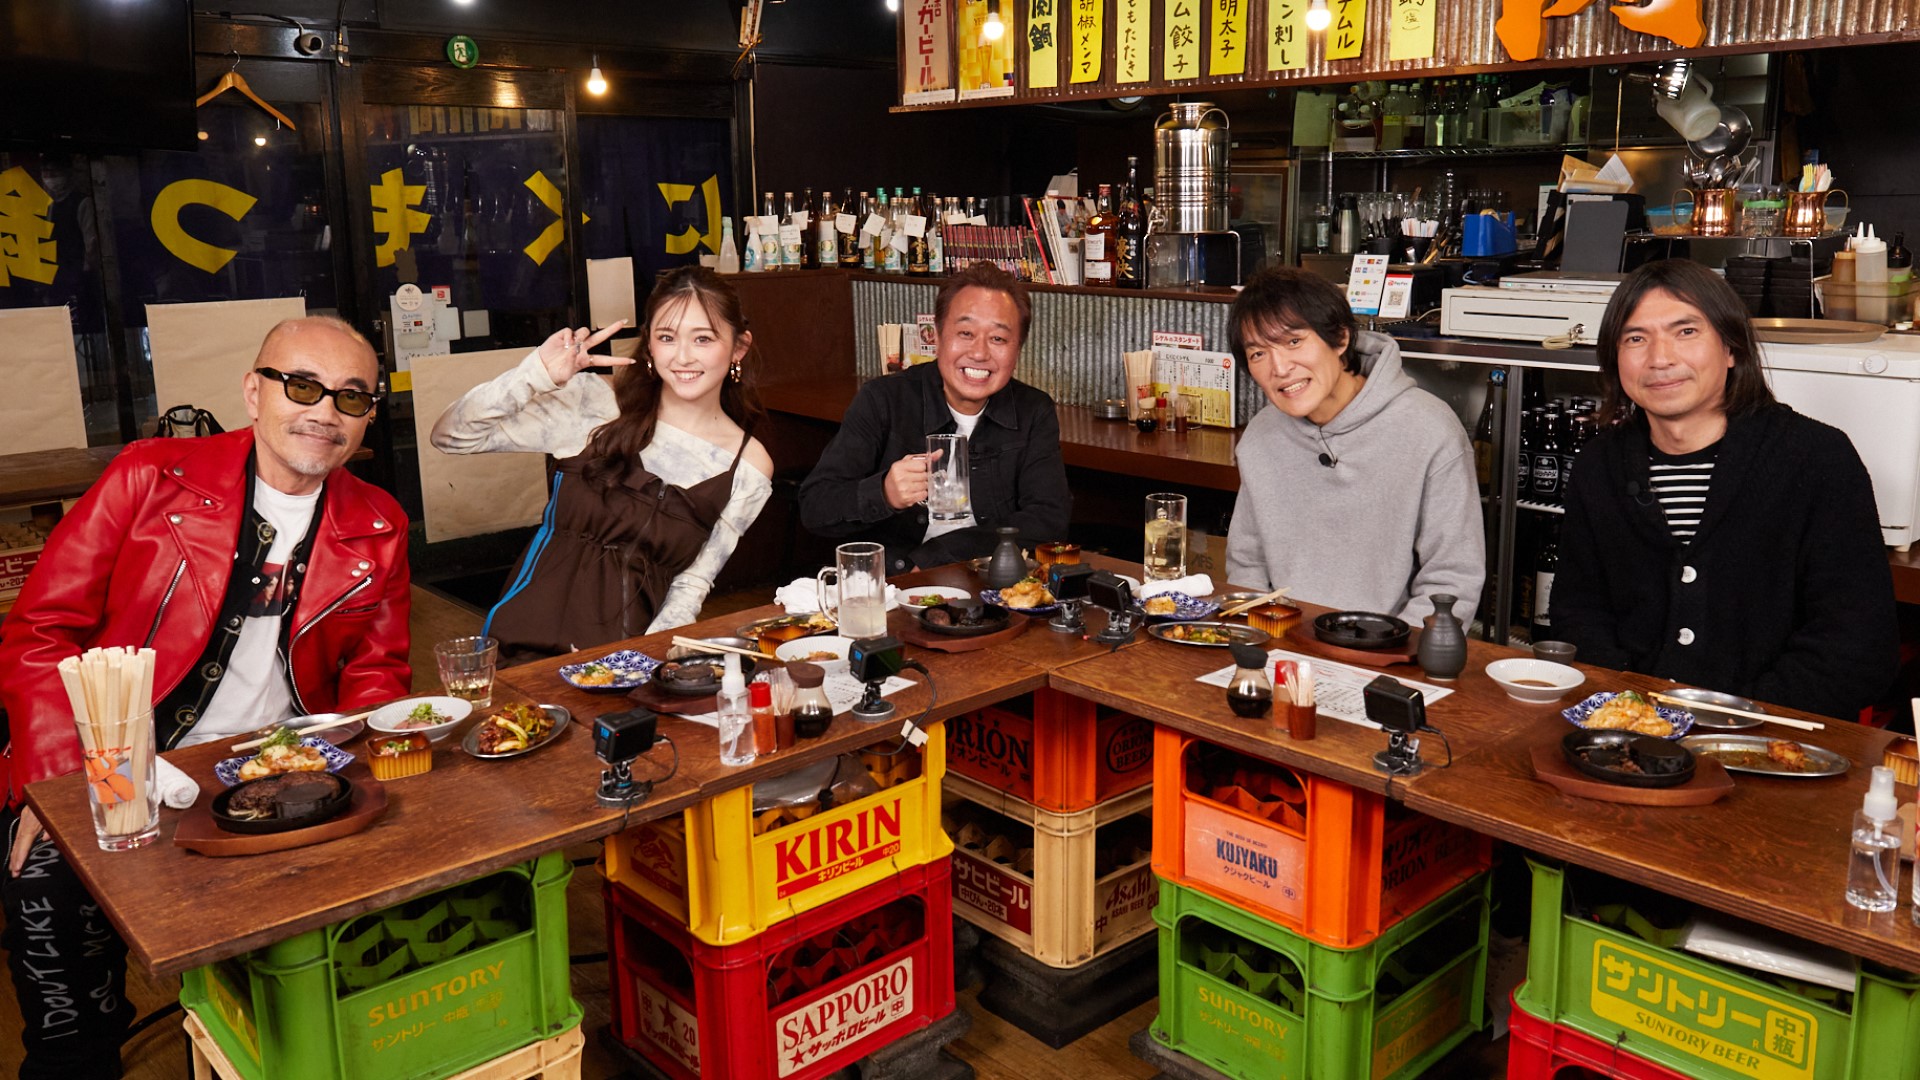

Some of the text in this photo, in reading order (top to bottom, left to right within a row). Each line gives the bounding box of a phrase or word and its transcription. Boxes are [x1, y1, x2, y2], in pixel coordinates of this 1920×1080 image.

[1169, 1, 1193, 73] ム餃子
[1218, 0, 1237, 58] 明太子
[1274, 4, 1294, 65] ン刺し
[0, 554, 41, 576] ビー
[1112, 729, 1153, 756] ORION
[1116, 747, 1148, 768] BEER
[775, 799, 902, 884] KIRIN
[818, 857, 864, 882] キリンビール
[882, 843, 900, 857] 中20
[1216, 838, 1278, 879] KUJYAKU
[950, 855, 1029, 910] サヒビール
[1105, 871, 1151, 911] Asahi
[1223, 865, 1271, 888] クジャクビール
[20, 896, 61, 957] LIKE
[1095, 915, 1107, 933] 中
[1111, 898, 1145, 919] ASAHI BEER
[22, 958, 79, 1029] DON'T
[368, 960, 505, 1027] SUNTORY
[782, 965, 909, 1052] SAPPORO
[891, 998, 905, 1015] 中
[1199, 986, 1288, 1040] SUNTORY
[1601, 954, 1762, 1029] サントリー
[371, 1021, 437, 1052] サントリー
[682, 1021, 697, 1047] 20
[808, 1008, 887, 1057] サッポロビール
[1634, 1011, 1761, 1070] SUNTORY BEER
[1772, 1016, 1797, 1059] 中瓶
